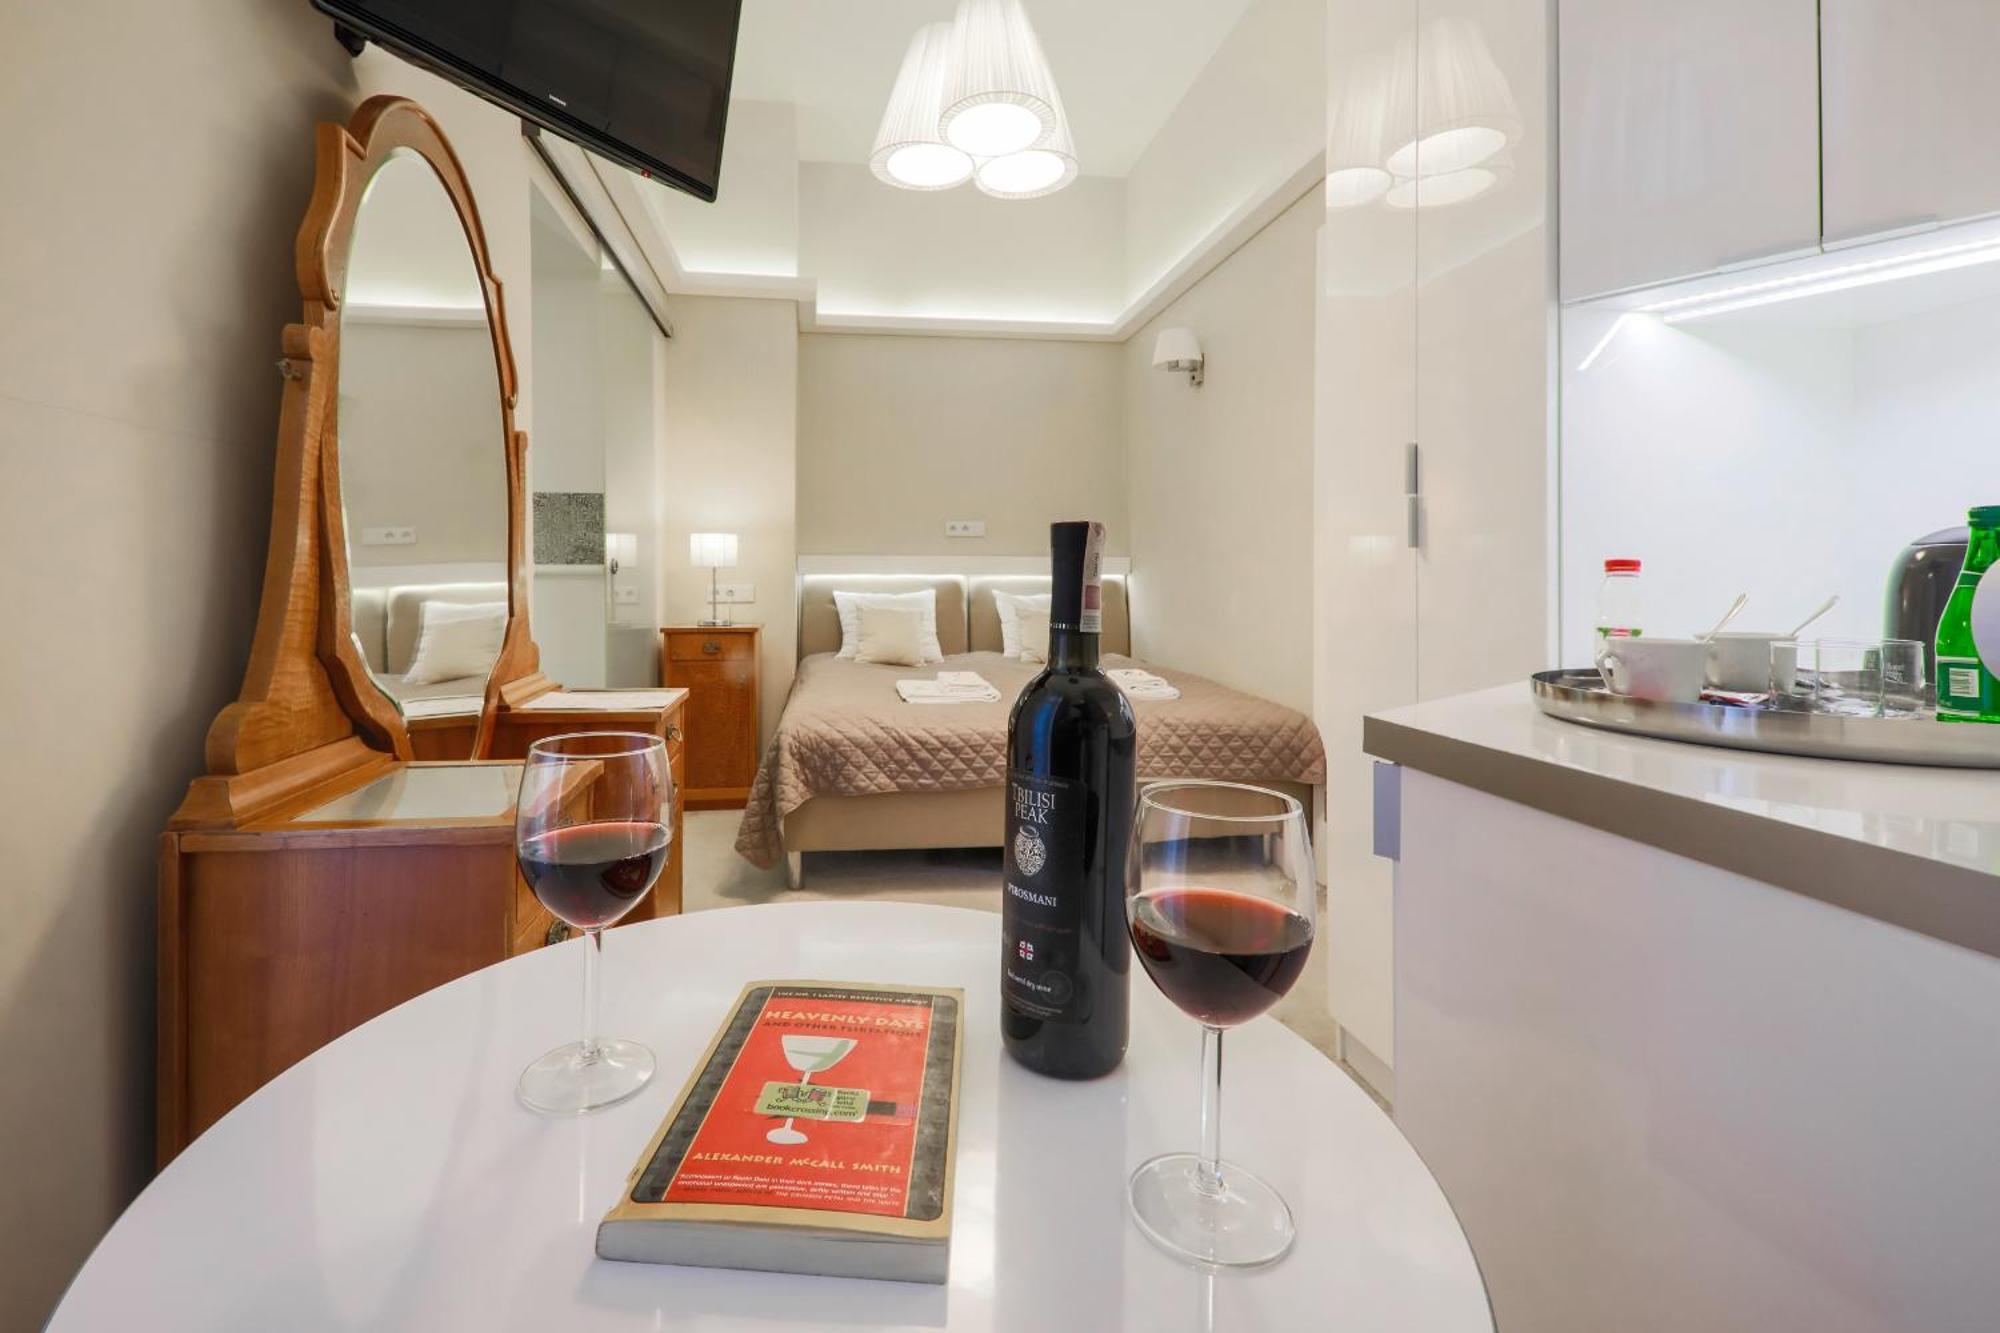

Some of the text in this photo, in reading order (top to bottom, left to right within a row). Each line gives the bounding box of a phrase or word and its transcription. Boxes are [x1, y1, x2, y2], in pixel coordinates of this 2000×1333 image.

[1011, 782, 1056, 810] TBILISI
[1015, 802, 1048, 825] PEAK
[1007, 882, 1057, 908] PIROSMANI
[765, 1010, 927, 1030] HEAVENLY DATE
[795, 1022, 838, 1031] OTHER
[692, 1153, 783, 1165] ALEXANDER
[852, 1163, 901, 1174] SMITH
